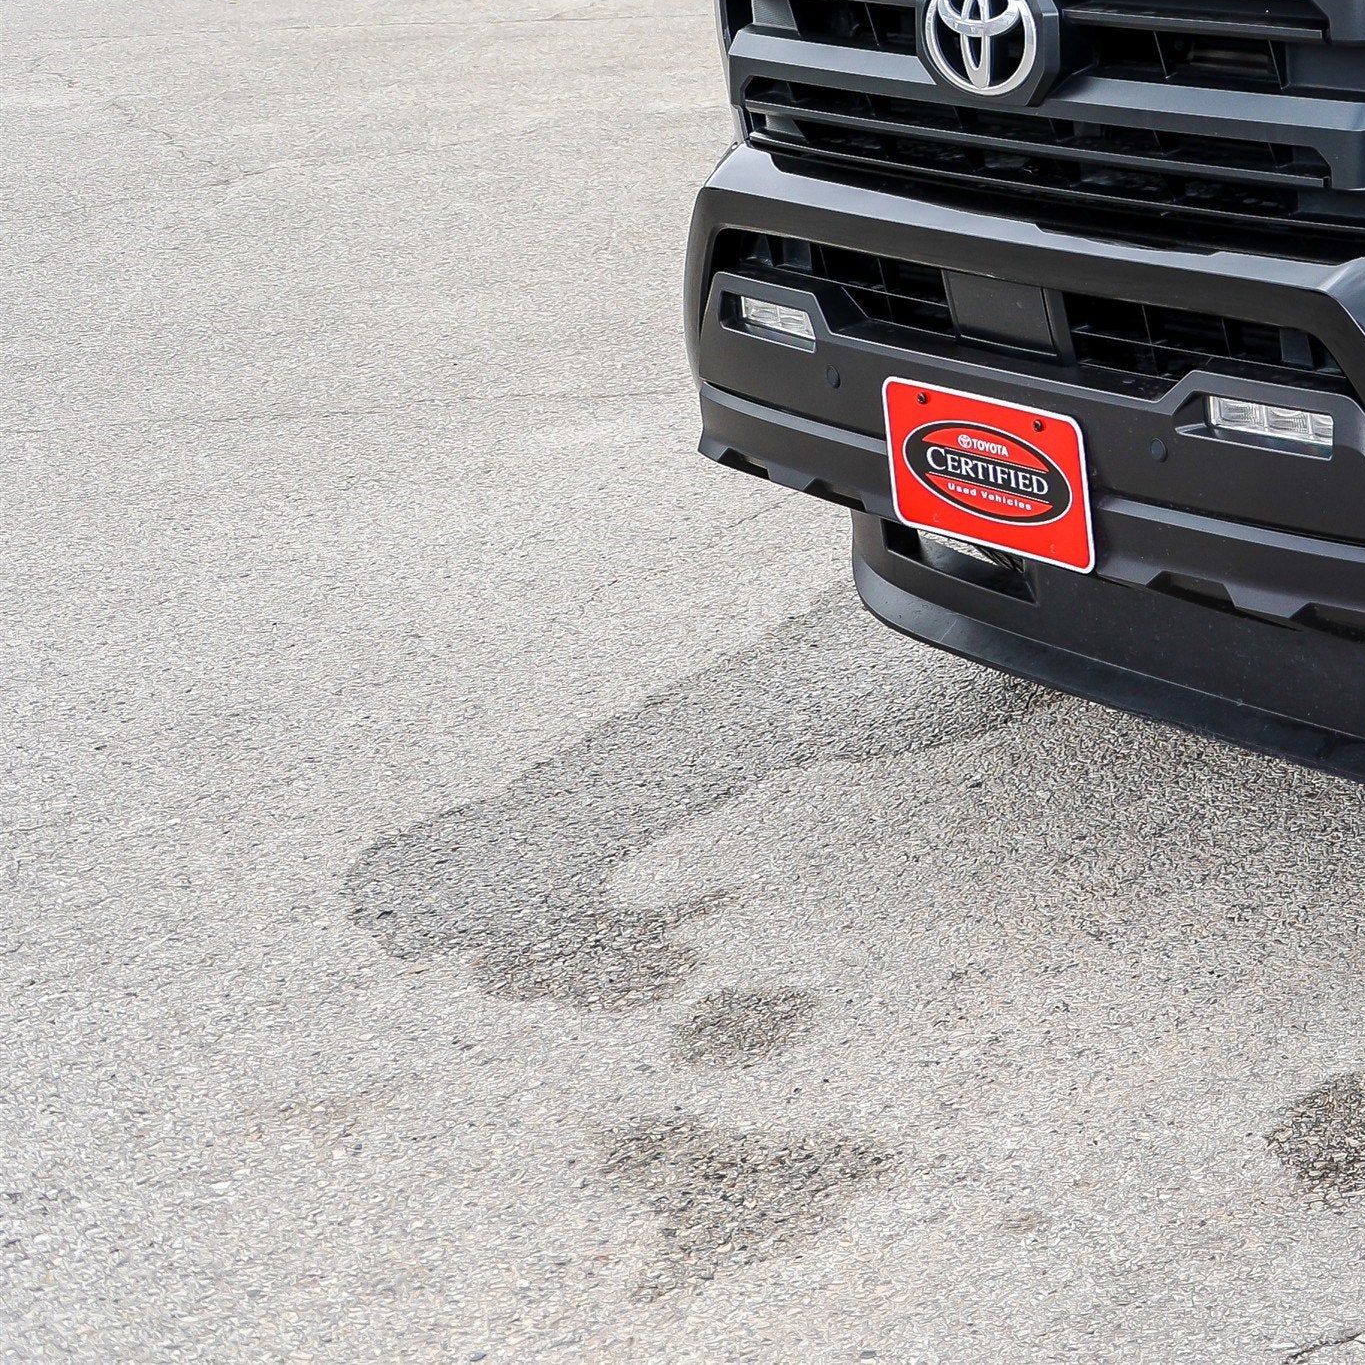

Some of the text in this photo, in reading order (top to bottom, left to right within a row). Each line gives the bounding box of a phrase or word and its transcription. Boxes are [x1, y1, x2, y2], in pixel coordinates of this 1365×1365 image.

[972, 438, 1009, 457] TOYOTA
[926, 446, 1049, 495] CERTIFIED
[947, 482, 1033, 511] Used Vehicles
